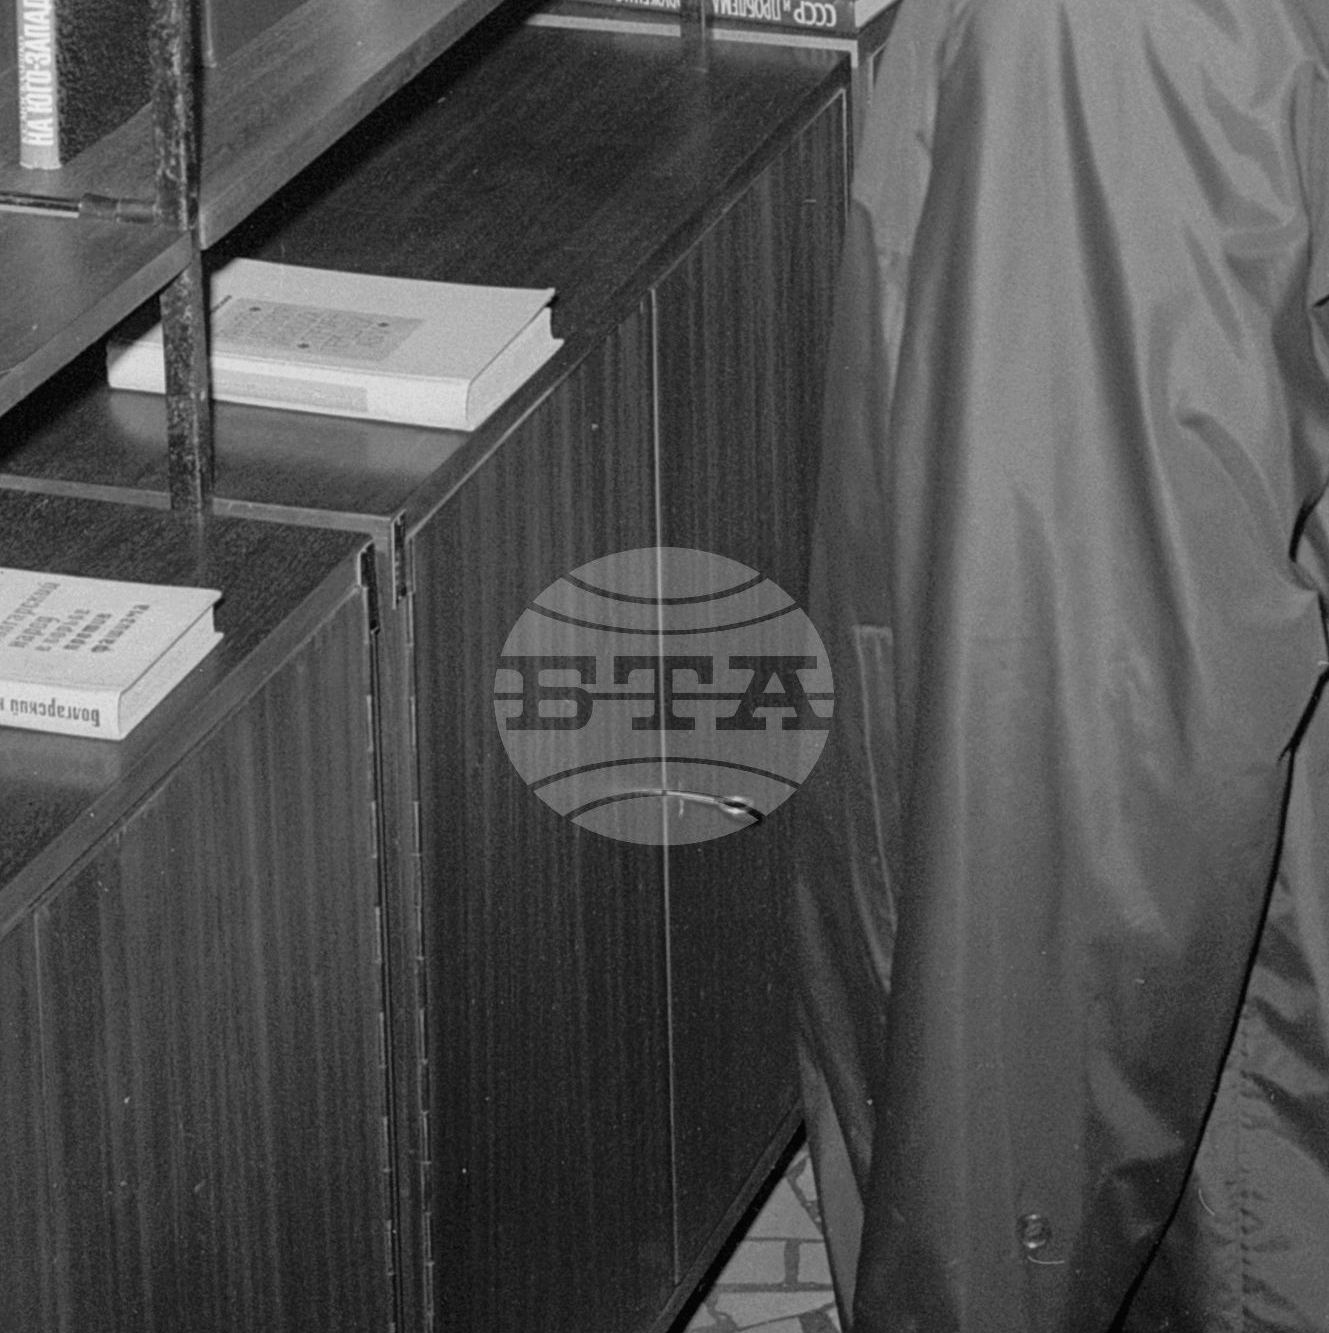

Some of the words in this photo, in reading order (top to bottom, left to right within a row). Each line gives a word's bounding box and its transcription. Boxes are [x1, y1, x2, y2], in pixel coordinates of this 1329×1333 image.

[782, 1, 792, 12] и
[795, 0, 837, 27] СССР
[28, 117, 55, 147] НА
[8, 614, 61, 650] народ
[10, 699, 100, 728] Болгарский
